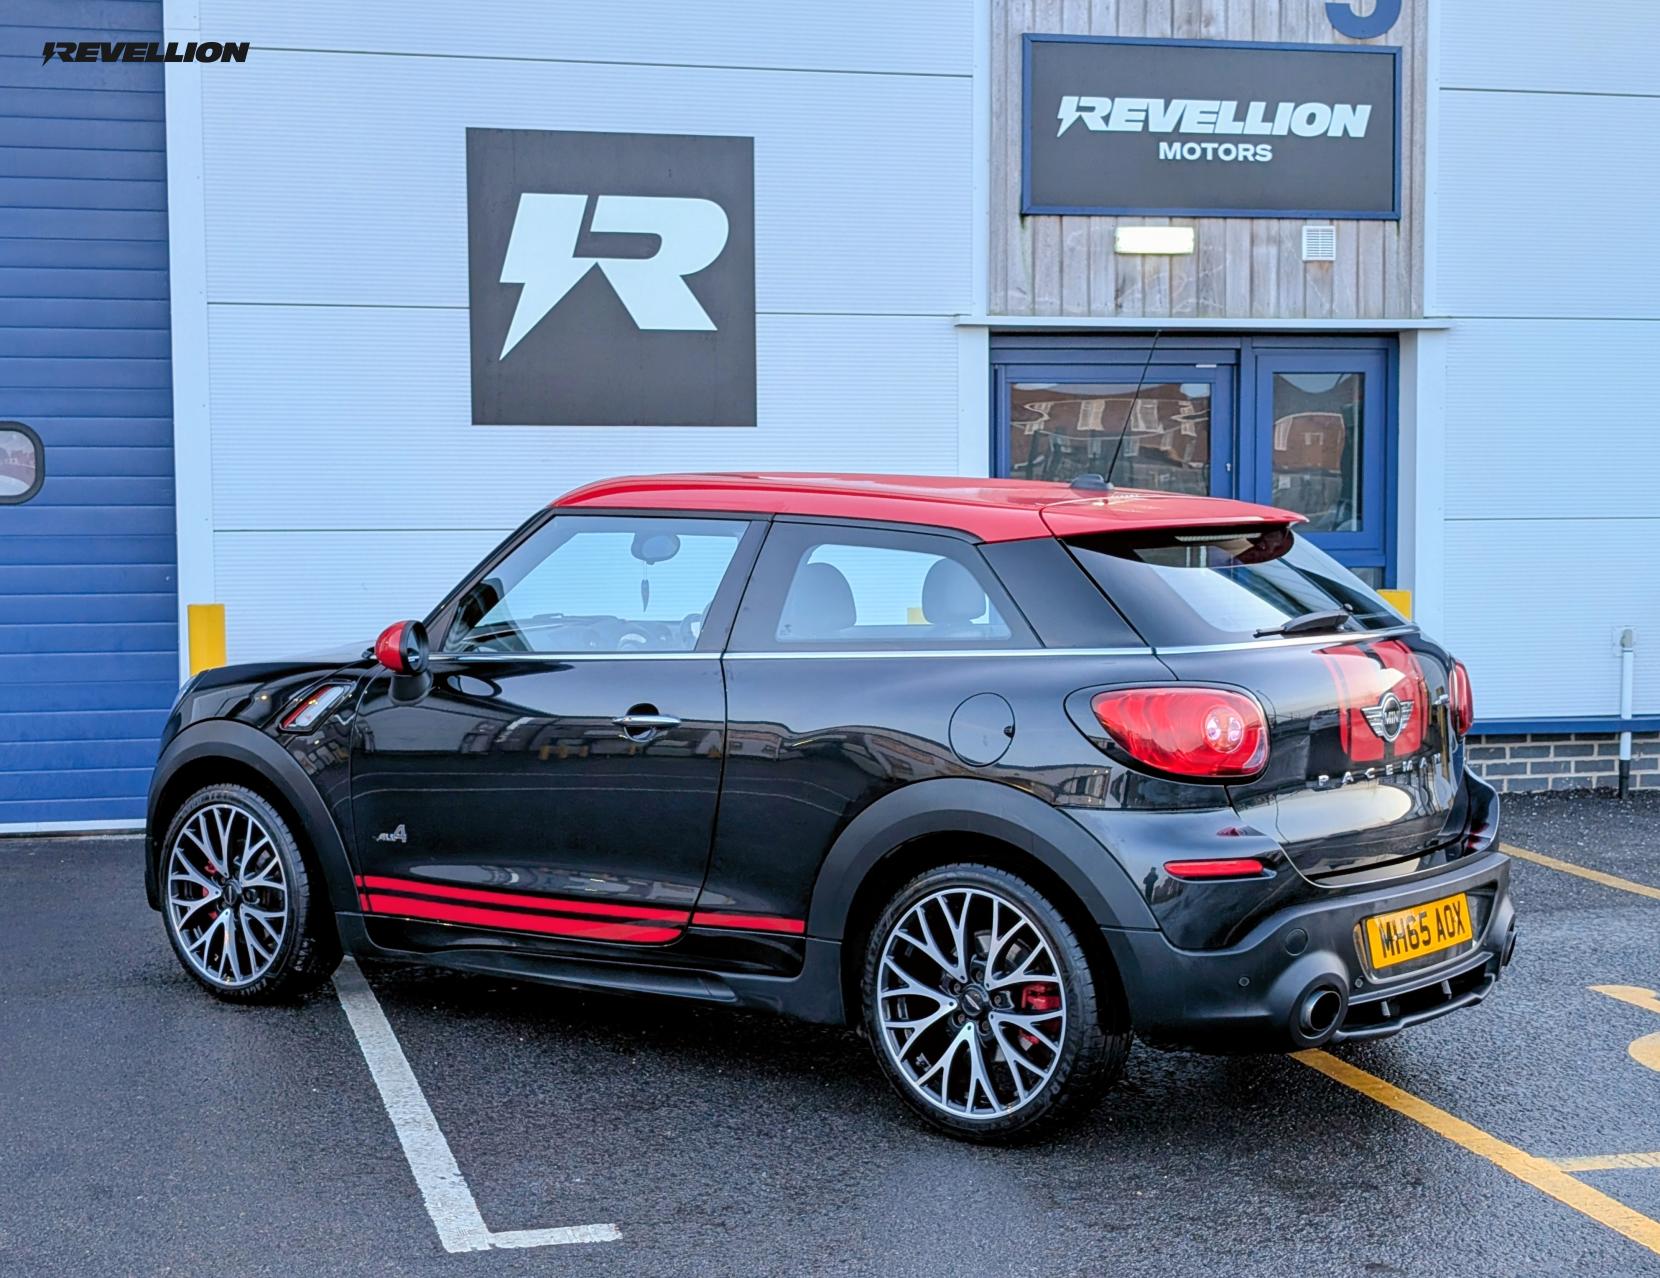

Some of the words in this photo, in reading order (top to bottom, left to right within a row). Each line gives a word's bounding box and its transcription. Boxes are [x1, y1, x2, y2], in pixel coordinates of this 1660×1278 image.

[1057, 96, 1372, 138] REVELLION
[1158, 142, 1273, 162] MOTORS
[499, 192, 729, 361] R
[1379, 911, 1432, 958] MH65
[1435, 901, 1465, 942] AOX
